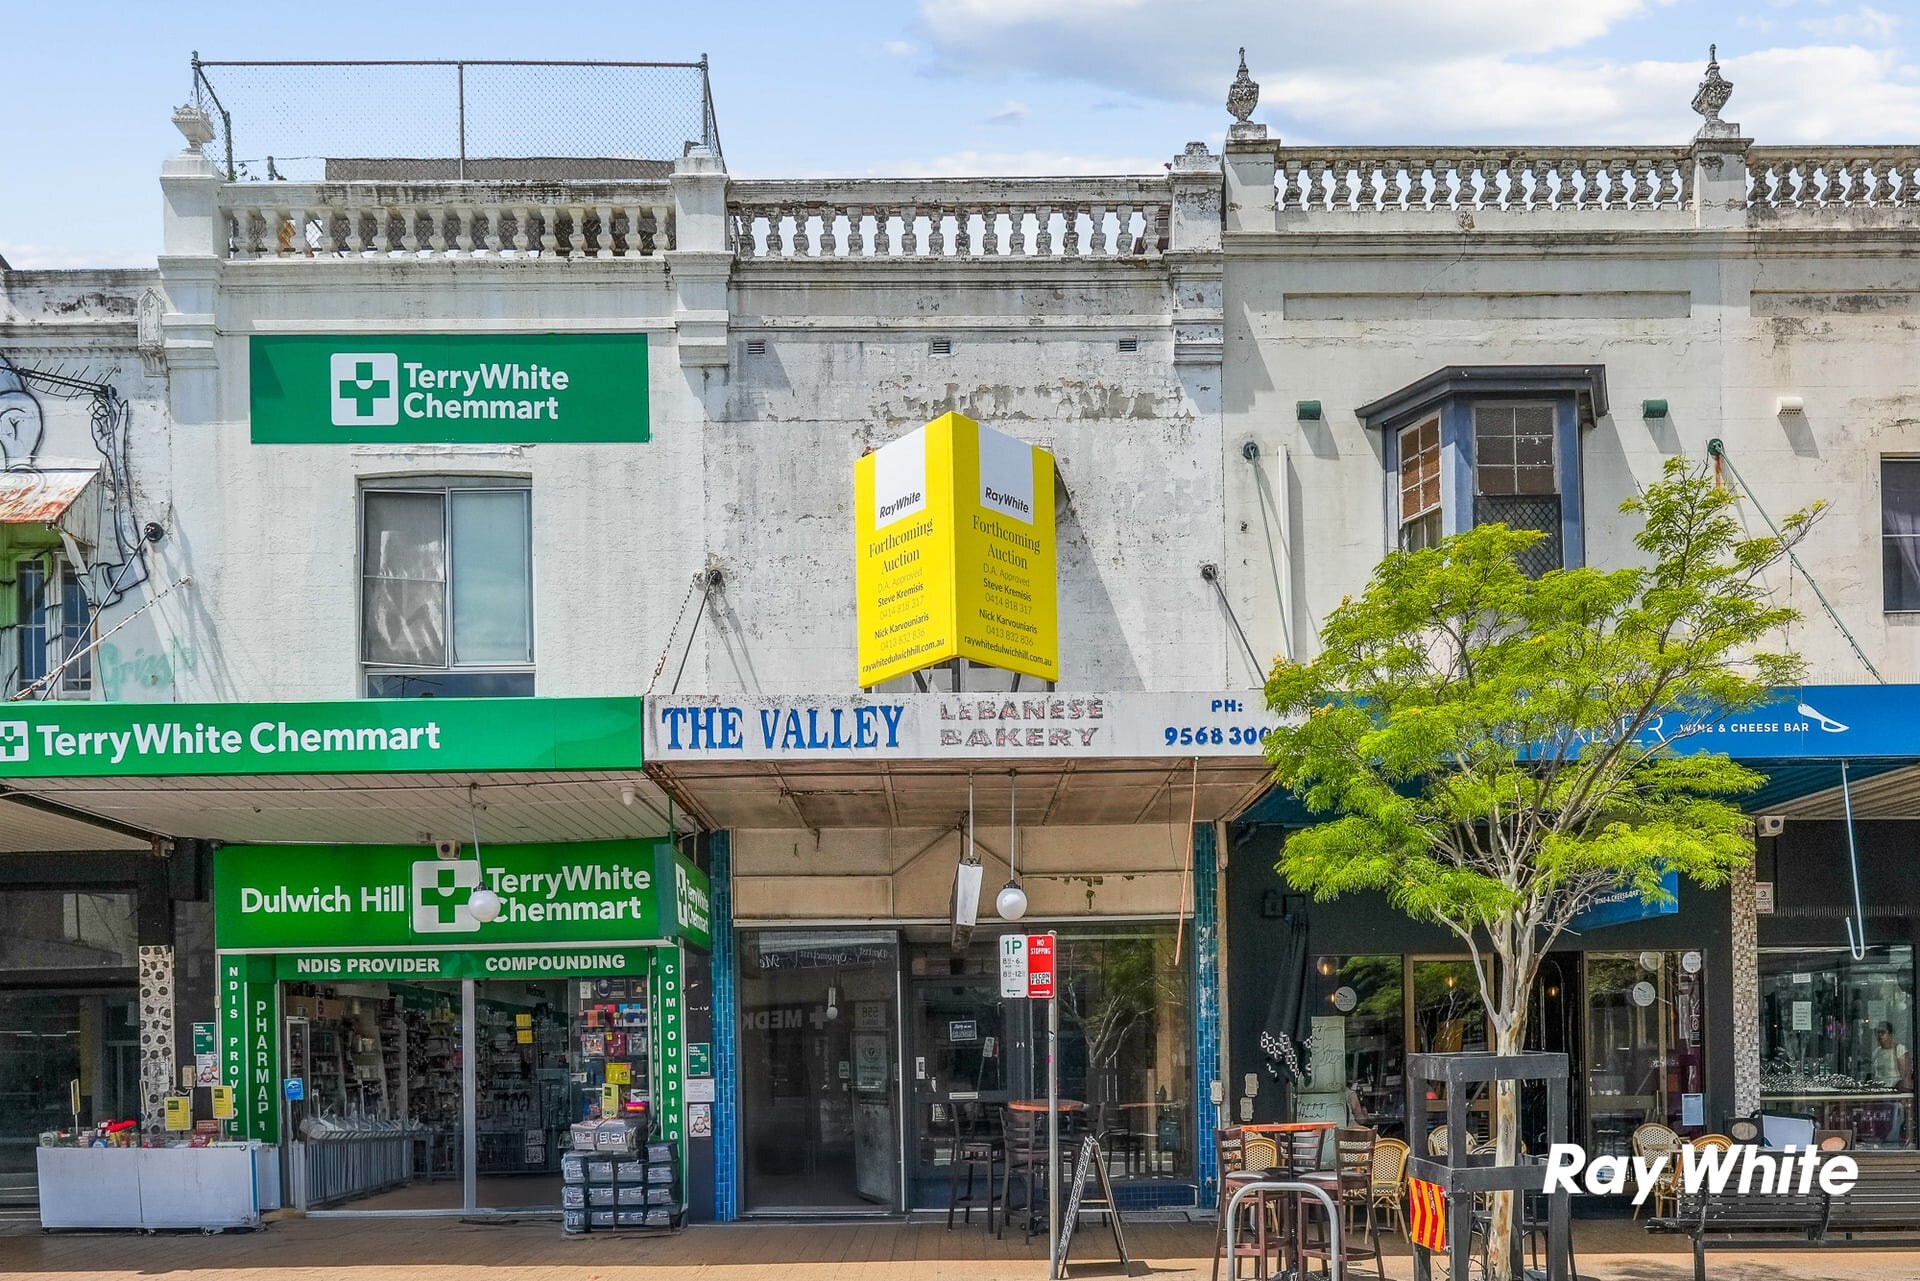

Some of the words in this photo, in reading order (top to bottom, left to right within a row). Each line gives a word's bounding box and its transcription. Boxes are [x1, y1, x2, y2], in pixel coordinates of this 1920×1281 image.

[403, 362, 569, 396] TerryWhite
[403, 392, 560, 420] Chemmart
[869, 518, 934, 558] Forthcoming
[972, 514, 1041, 555] Forthcoming
[881, 547, 920, 575] Auction
[987, 543, 1028, 570] Auction
[891, 567, 923, 589] Approved
[999, 567, 1030, 588] Approved
[877, 594, 895, 608] Steve
[896, 582, 924, 600] Kremisis
[983, 577, 1003, 593] Steve
[1003, 584, 1032, 602] Kremisis
[879, 608, 896, 620] 0414
[911, 596, 925, 610] 317
[979, 608, 995, 621] Nick
[985, 592, 1003, 607] 0414
[1004, 598, 1018, 611] 818
[1018, 602, 1032, 615] 317
[874, 628, 889, 640] Nick
[880, 639, 897, 651] 0413
[985, 625, 1004, 638] 0413
[1005, 629, 1019, 643] 832
[1019, 634, 1034, 647] 836
[862, 637, 945, 673] raywhitedulwichhill.com.au
[964, 635, 1052, 667] raywhitedulwichhill.com.au
[939, 699, 1105, 721] LEBANESE
[1211, 699, 1244, 713] PH:
[661, 705, 743, 750] THE
[760, 705, 905, 751] VALLEY
[939, 727, 1100, 748] BAKERY
[1164, 726, 1223, 746] 9568
[1680, 723, 1714, 733] WINE
[1718, 723, 1726, 733] &
[1730, 723, 1781, 733] CHEESE
[1783, 722, 1809, 732] BAR
[36, 722, 243, 764] TerryWhite
[250, 721, 441, 754] Chemmart
[486, 864, 651, 897] TerryWhite
[241, 885, 351, 914] Dulwich
[361, 885, 406, 913] Hill
[491, 895, 642, 923] Chemmart
[1005, 940, 1023, 955] 1P
[1030, 947, 1051, 955] STOPPING
[1036, 939, 1045, 947] NO
[296, 958, 341, 973] NDIS
[346, 958, 440, 973] PROVIDER
[485, 954, 626, 972] COMPOUNDING
